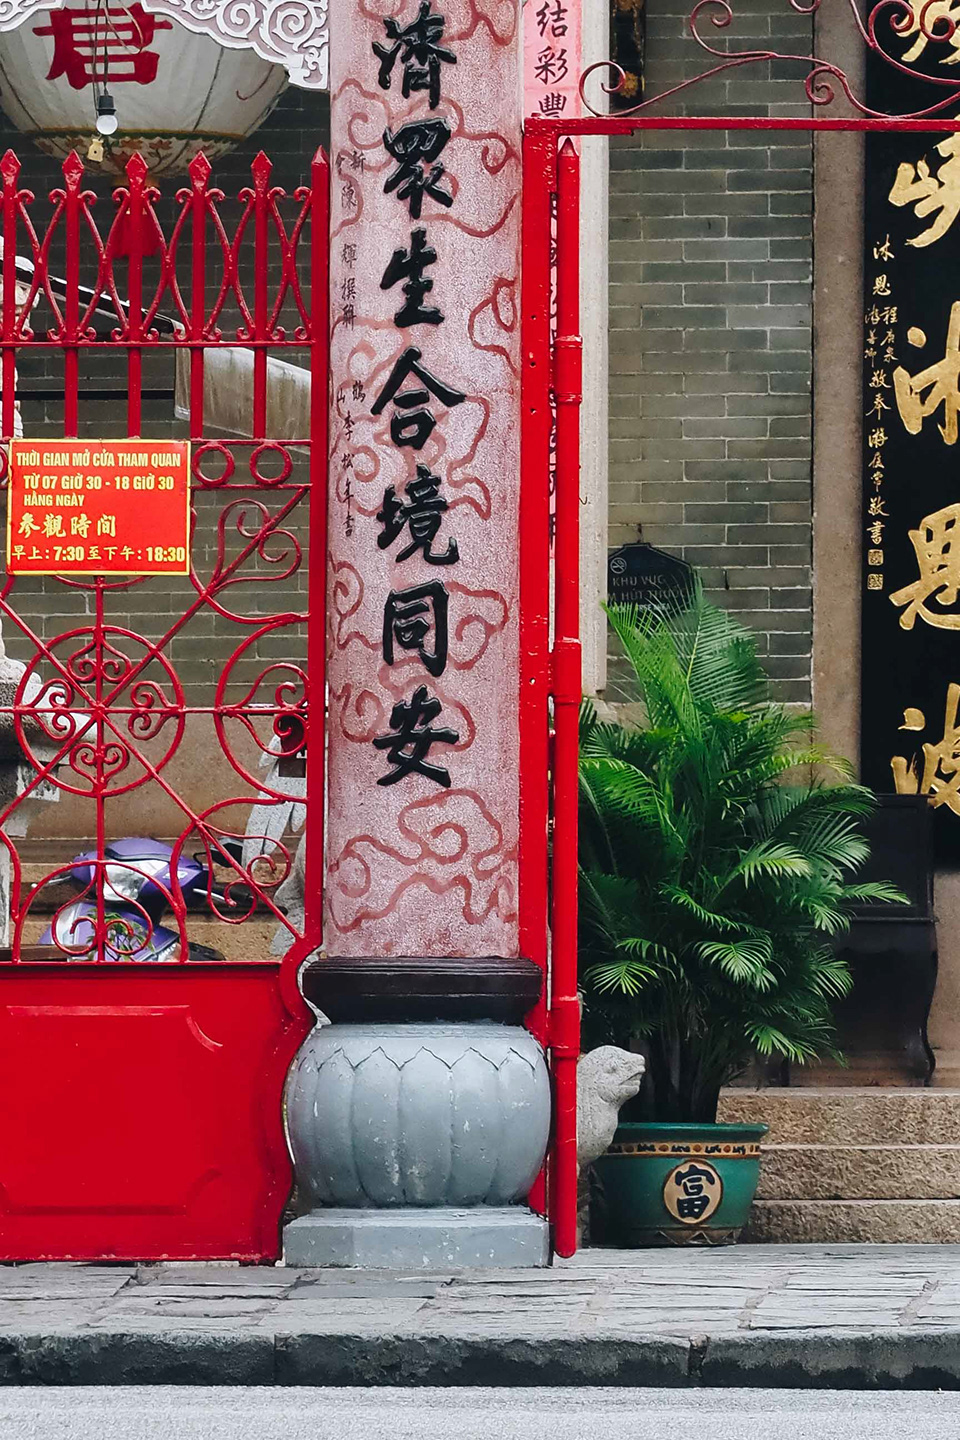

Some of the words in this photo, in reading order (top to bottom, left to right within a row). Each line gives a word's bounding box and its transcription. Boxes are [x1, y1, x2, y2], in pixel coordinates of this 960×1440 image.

[16, 449, 40, 467] THỜI
[43, 452, 70, 467] GIAN
[72, 449, 91, 467] MỞ
[93, 448, 115, 467] CỬA
[118, 453, 148, 467] THAM
[151, 453, 181, 468] QUAN
[23, 473, 41, 490] TỪ
[42, 475, 58, 489] 07
[86, 475, 102, 490] 30
[114, 476, 130, 490] 18
[158, 476, 174, 490] 30
[23, 490, 53, 507] HÀNG
[55, 492, 85, 507] NGÀY
[674, 1164, 716, 1220] 富
